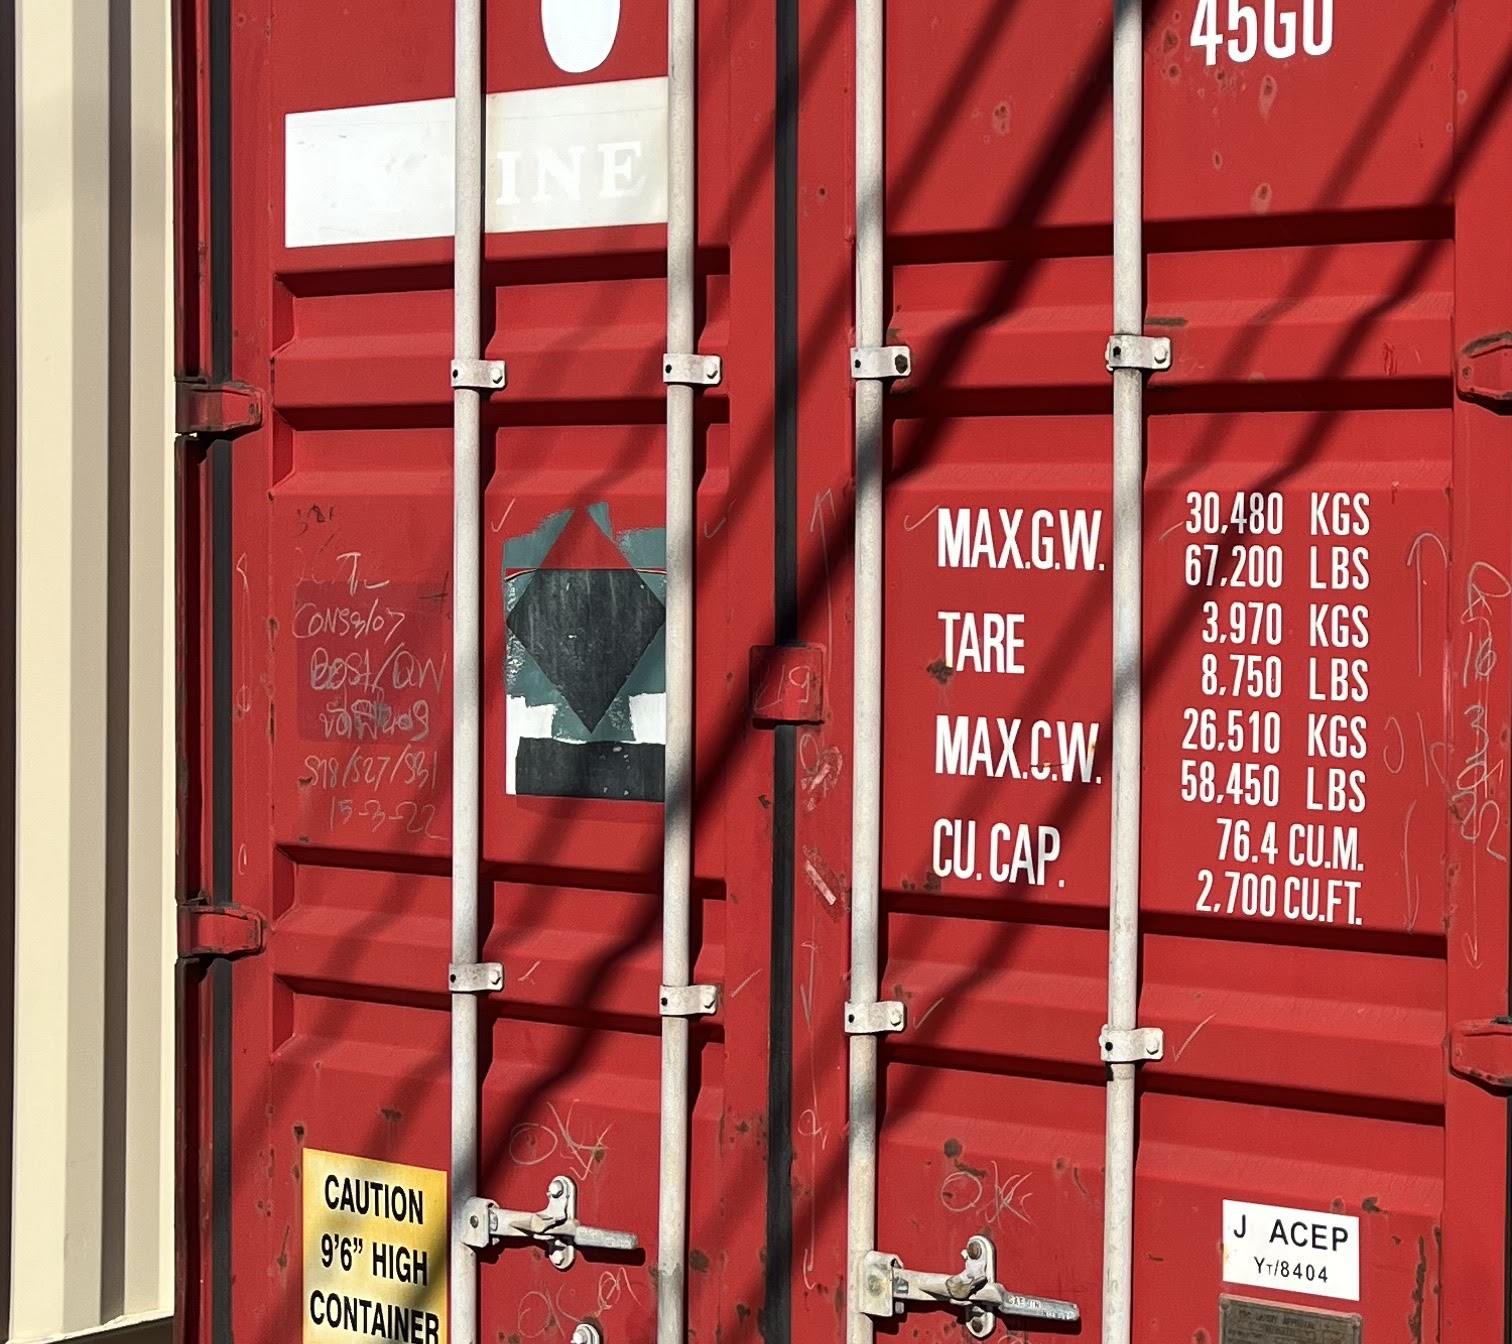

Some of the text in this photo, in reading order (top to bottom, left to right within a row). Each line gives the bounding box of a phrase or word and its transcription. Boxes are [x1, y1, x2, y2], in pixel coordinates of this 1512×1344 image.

[1186, 492, 1369, 535] 30,480 KGS
[938, 508, 1104, 570] MAX.G.W.
[1185, 544, 1369, 590] 67,200 LBS
[938, 611, 1025, 674] TARE
[1202, 601, 1368, 648] 3,970 KGS
[1202, 654, 1368, 702] 8,750 LBS
[936, 715, 1101, 784] MAX.C.W.
[1182, 708, 1366, 759] 26,510 KGS
[1181, 759, 1365, 812] 58,450 LBS
[1217, 818, 1278, 864] 76.4
[1196, 870, 1276, 917] 2,700
[324, 1174, 424, 1225] CAUTION
[1233, 1213, 1349, 1252] J ACEP
[372, 1241, 429, 1287] HIGH
